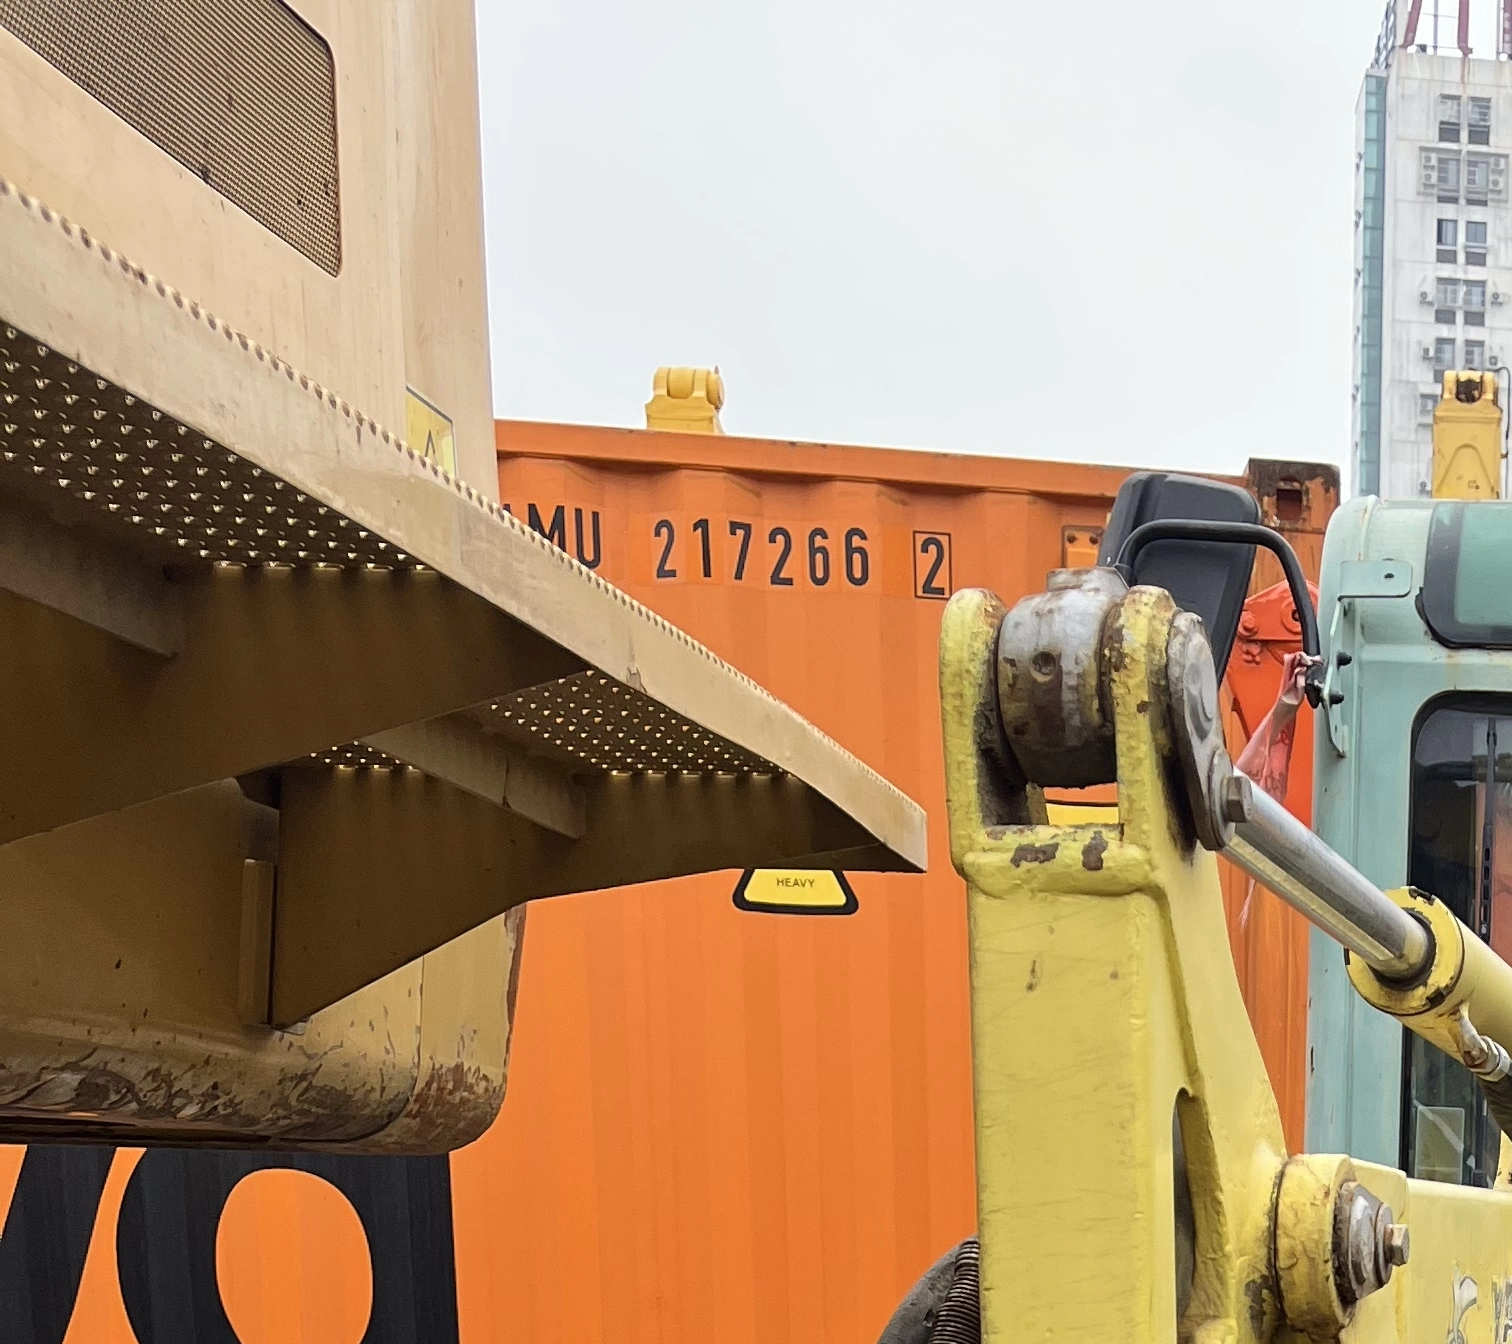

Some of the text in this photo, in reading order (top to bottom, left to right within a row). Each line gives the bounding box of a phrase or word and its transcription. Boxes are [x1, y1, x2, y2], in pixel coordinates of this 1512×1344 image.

[501, 503, 945, 595] MU 217266 2
[776, 877, 816, 888] HEAVY
